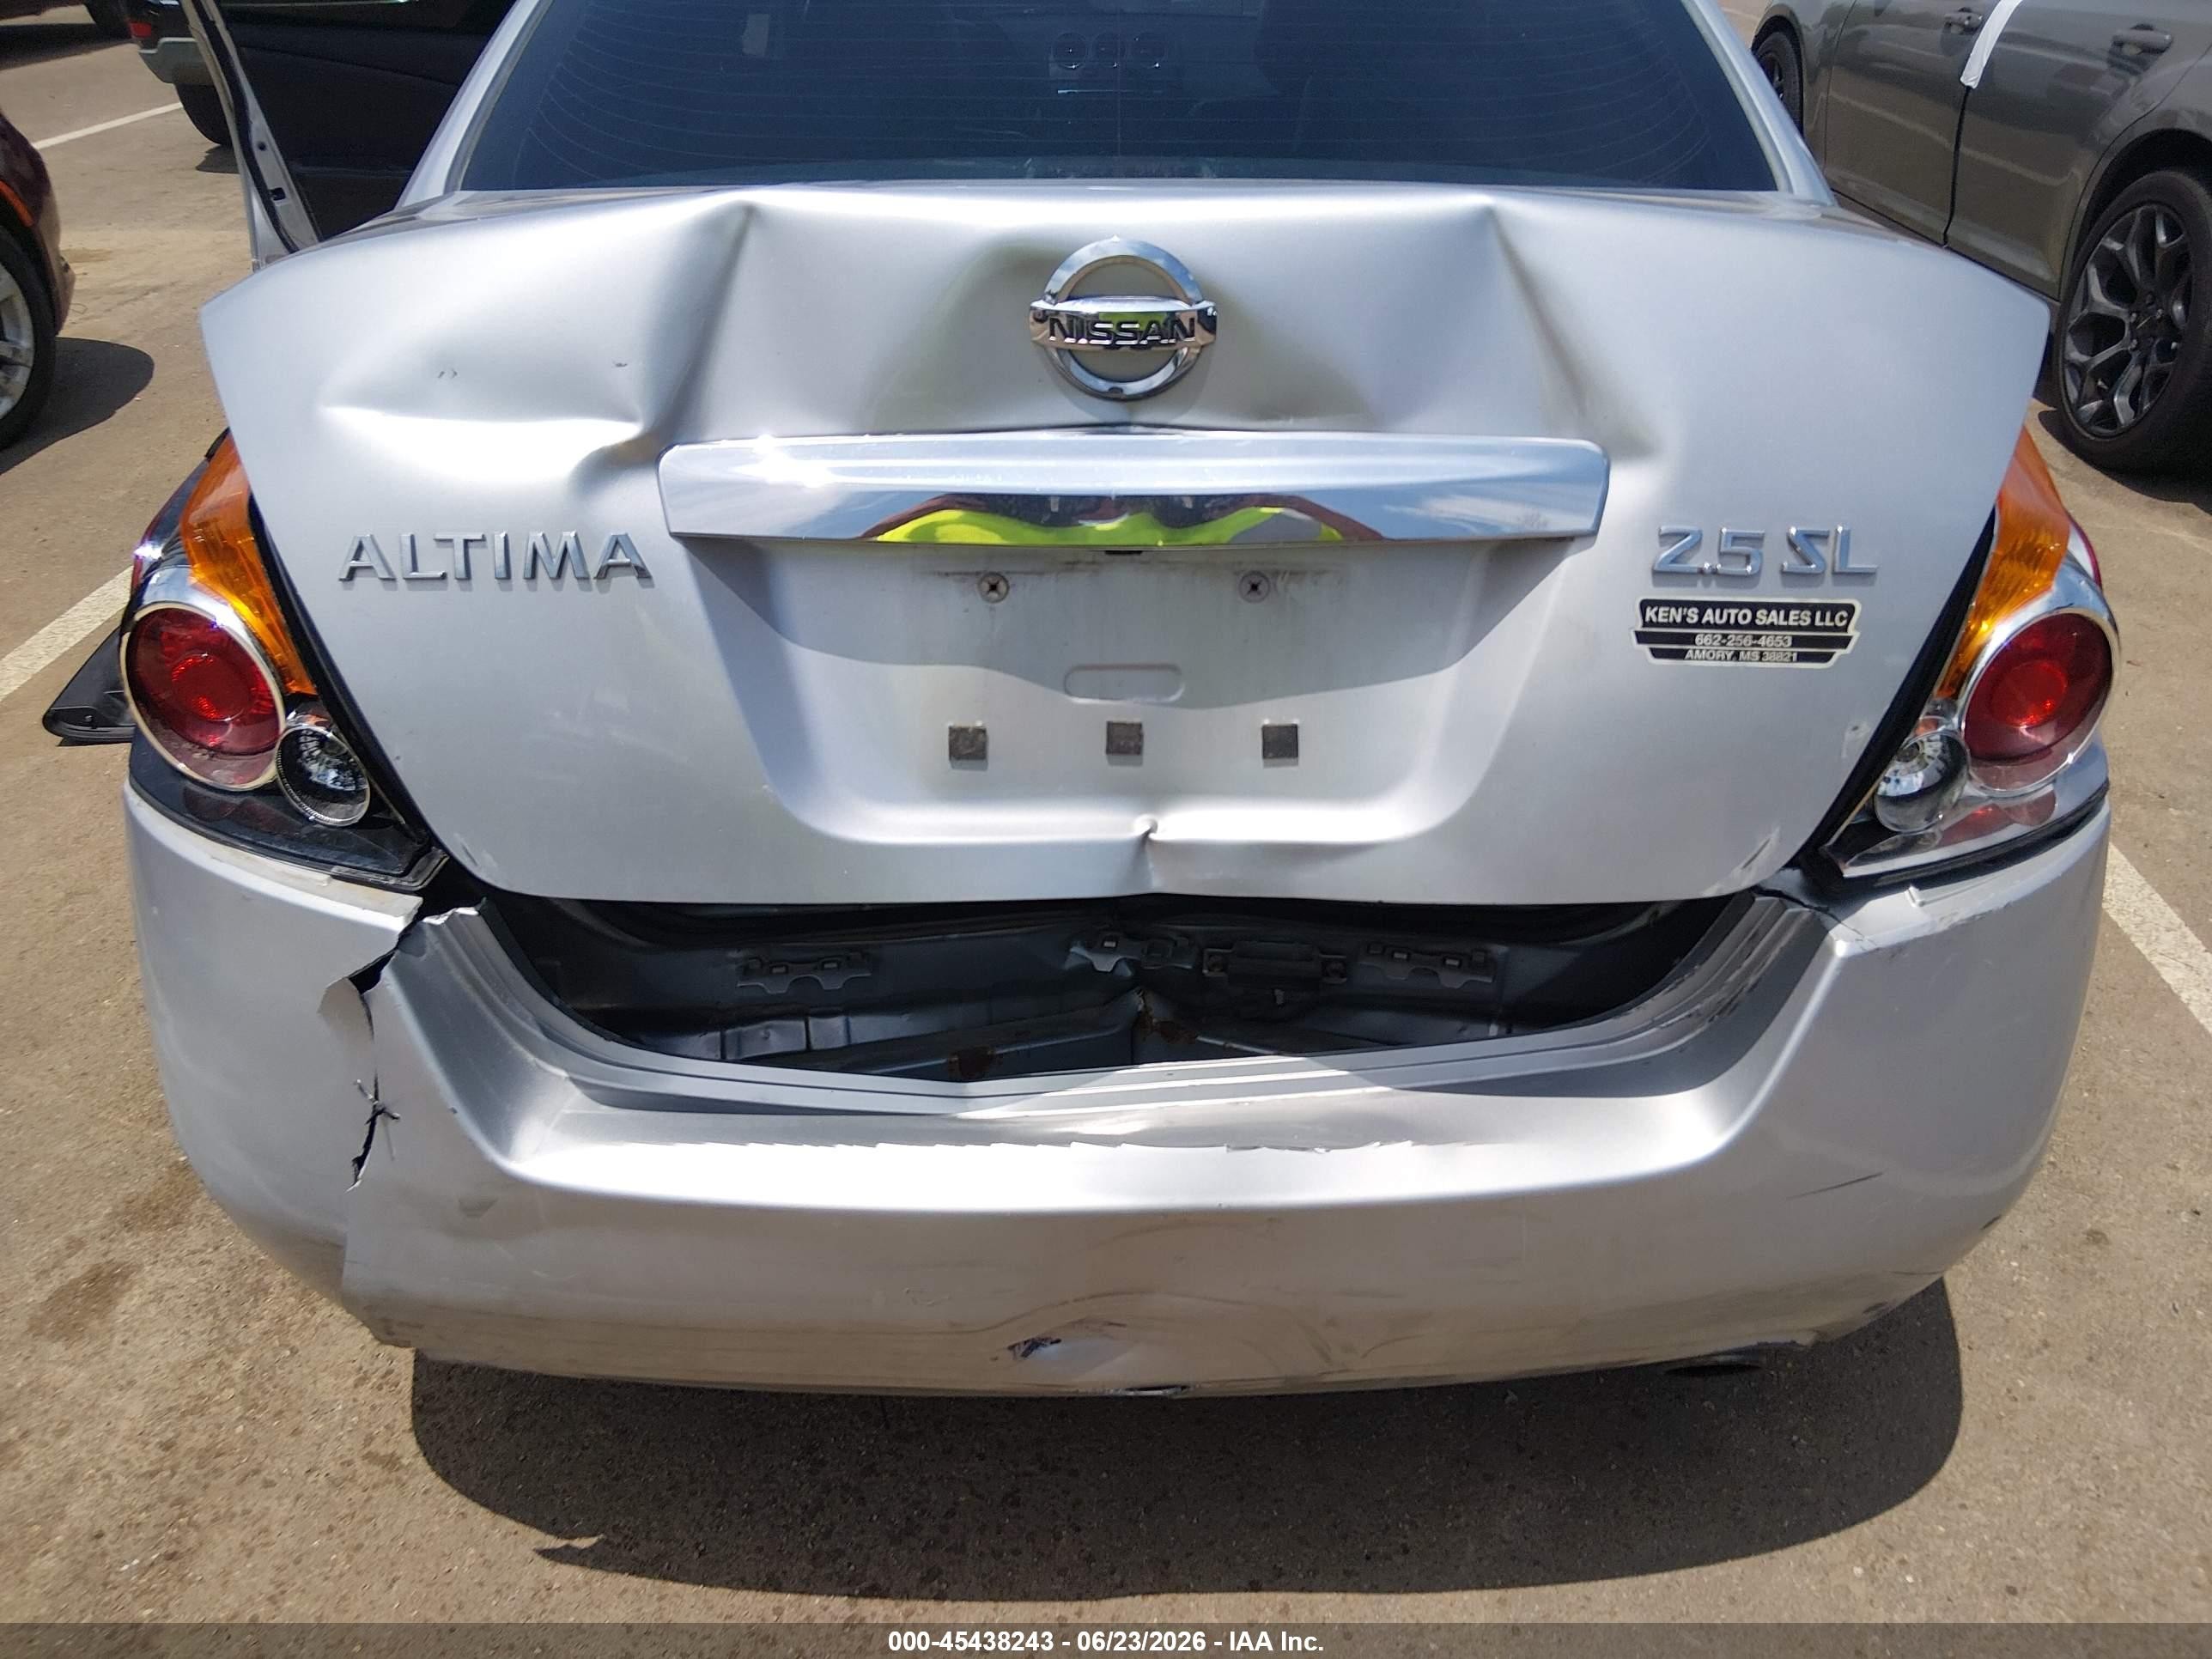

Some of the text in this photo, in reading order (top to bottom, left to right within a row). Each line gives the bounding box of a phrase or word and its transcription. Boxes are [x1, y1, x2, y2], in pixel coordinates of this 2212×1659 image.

[1048, 316, 1196, 345] NISSAN
[339, 531, 653, 582] ALTIMA
[1651, 525, 1879, 576] 2.5 SL
[1644, 606, 1849, 628] KEN'S AUTO SALES LLC
[1694, 633, 1793, 647] 662-256-4653
[1738, 650, 1760, 661] MS
